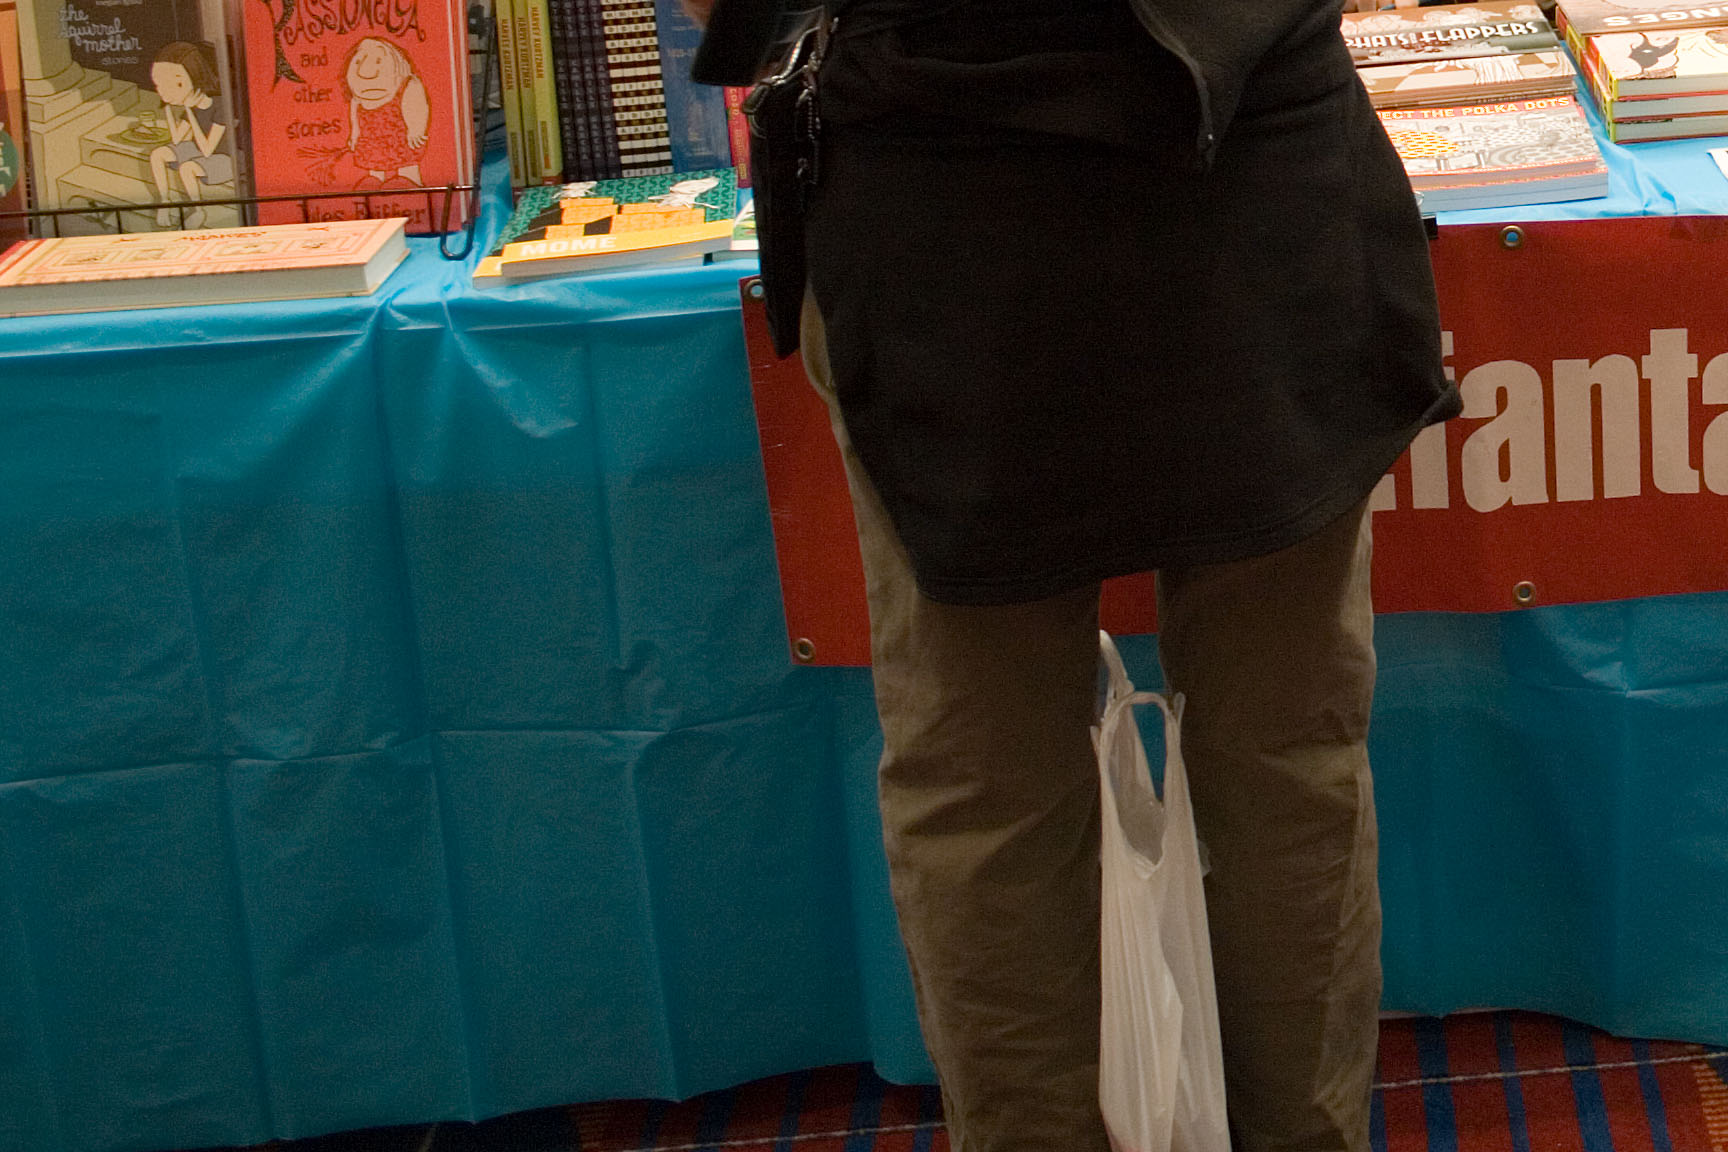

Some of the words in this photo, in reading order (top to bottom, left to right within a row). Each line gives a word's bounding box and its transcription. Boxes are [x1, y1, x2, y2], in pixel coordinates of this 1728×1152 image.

[530, 6, 542, 36] HARVEY
[1417, 21, 1539, 44] FLAPPERS
[82, 36, 142, 54] mother
[299, 46, 328, 68] and
[293, 85, 333, 103] other
[1422, 108, 1455, 118] THE
[1463, 102, 1518, 116] POLKA
[1525, 97, 1570, 111] DOTS
[287, 118, 342, 140] stories
[520, 236, 617, 257] MOME
